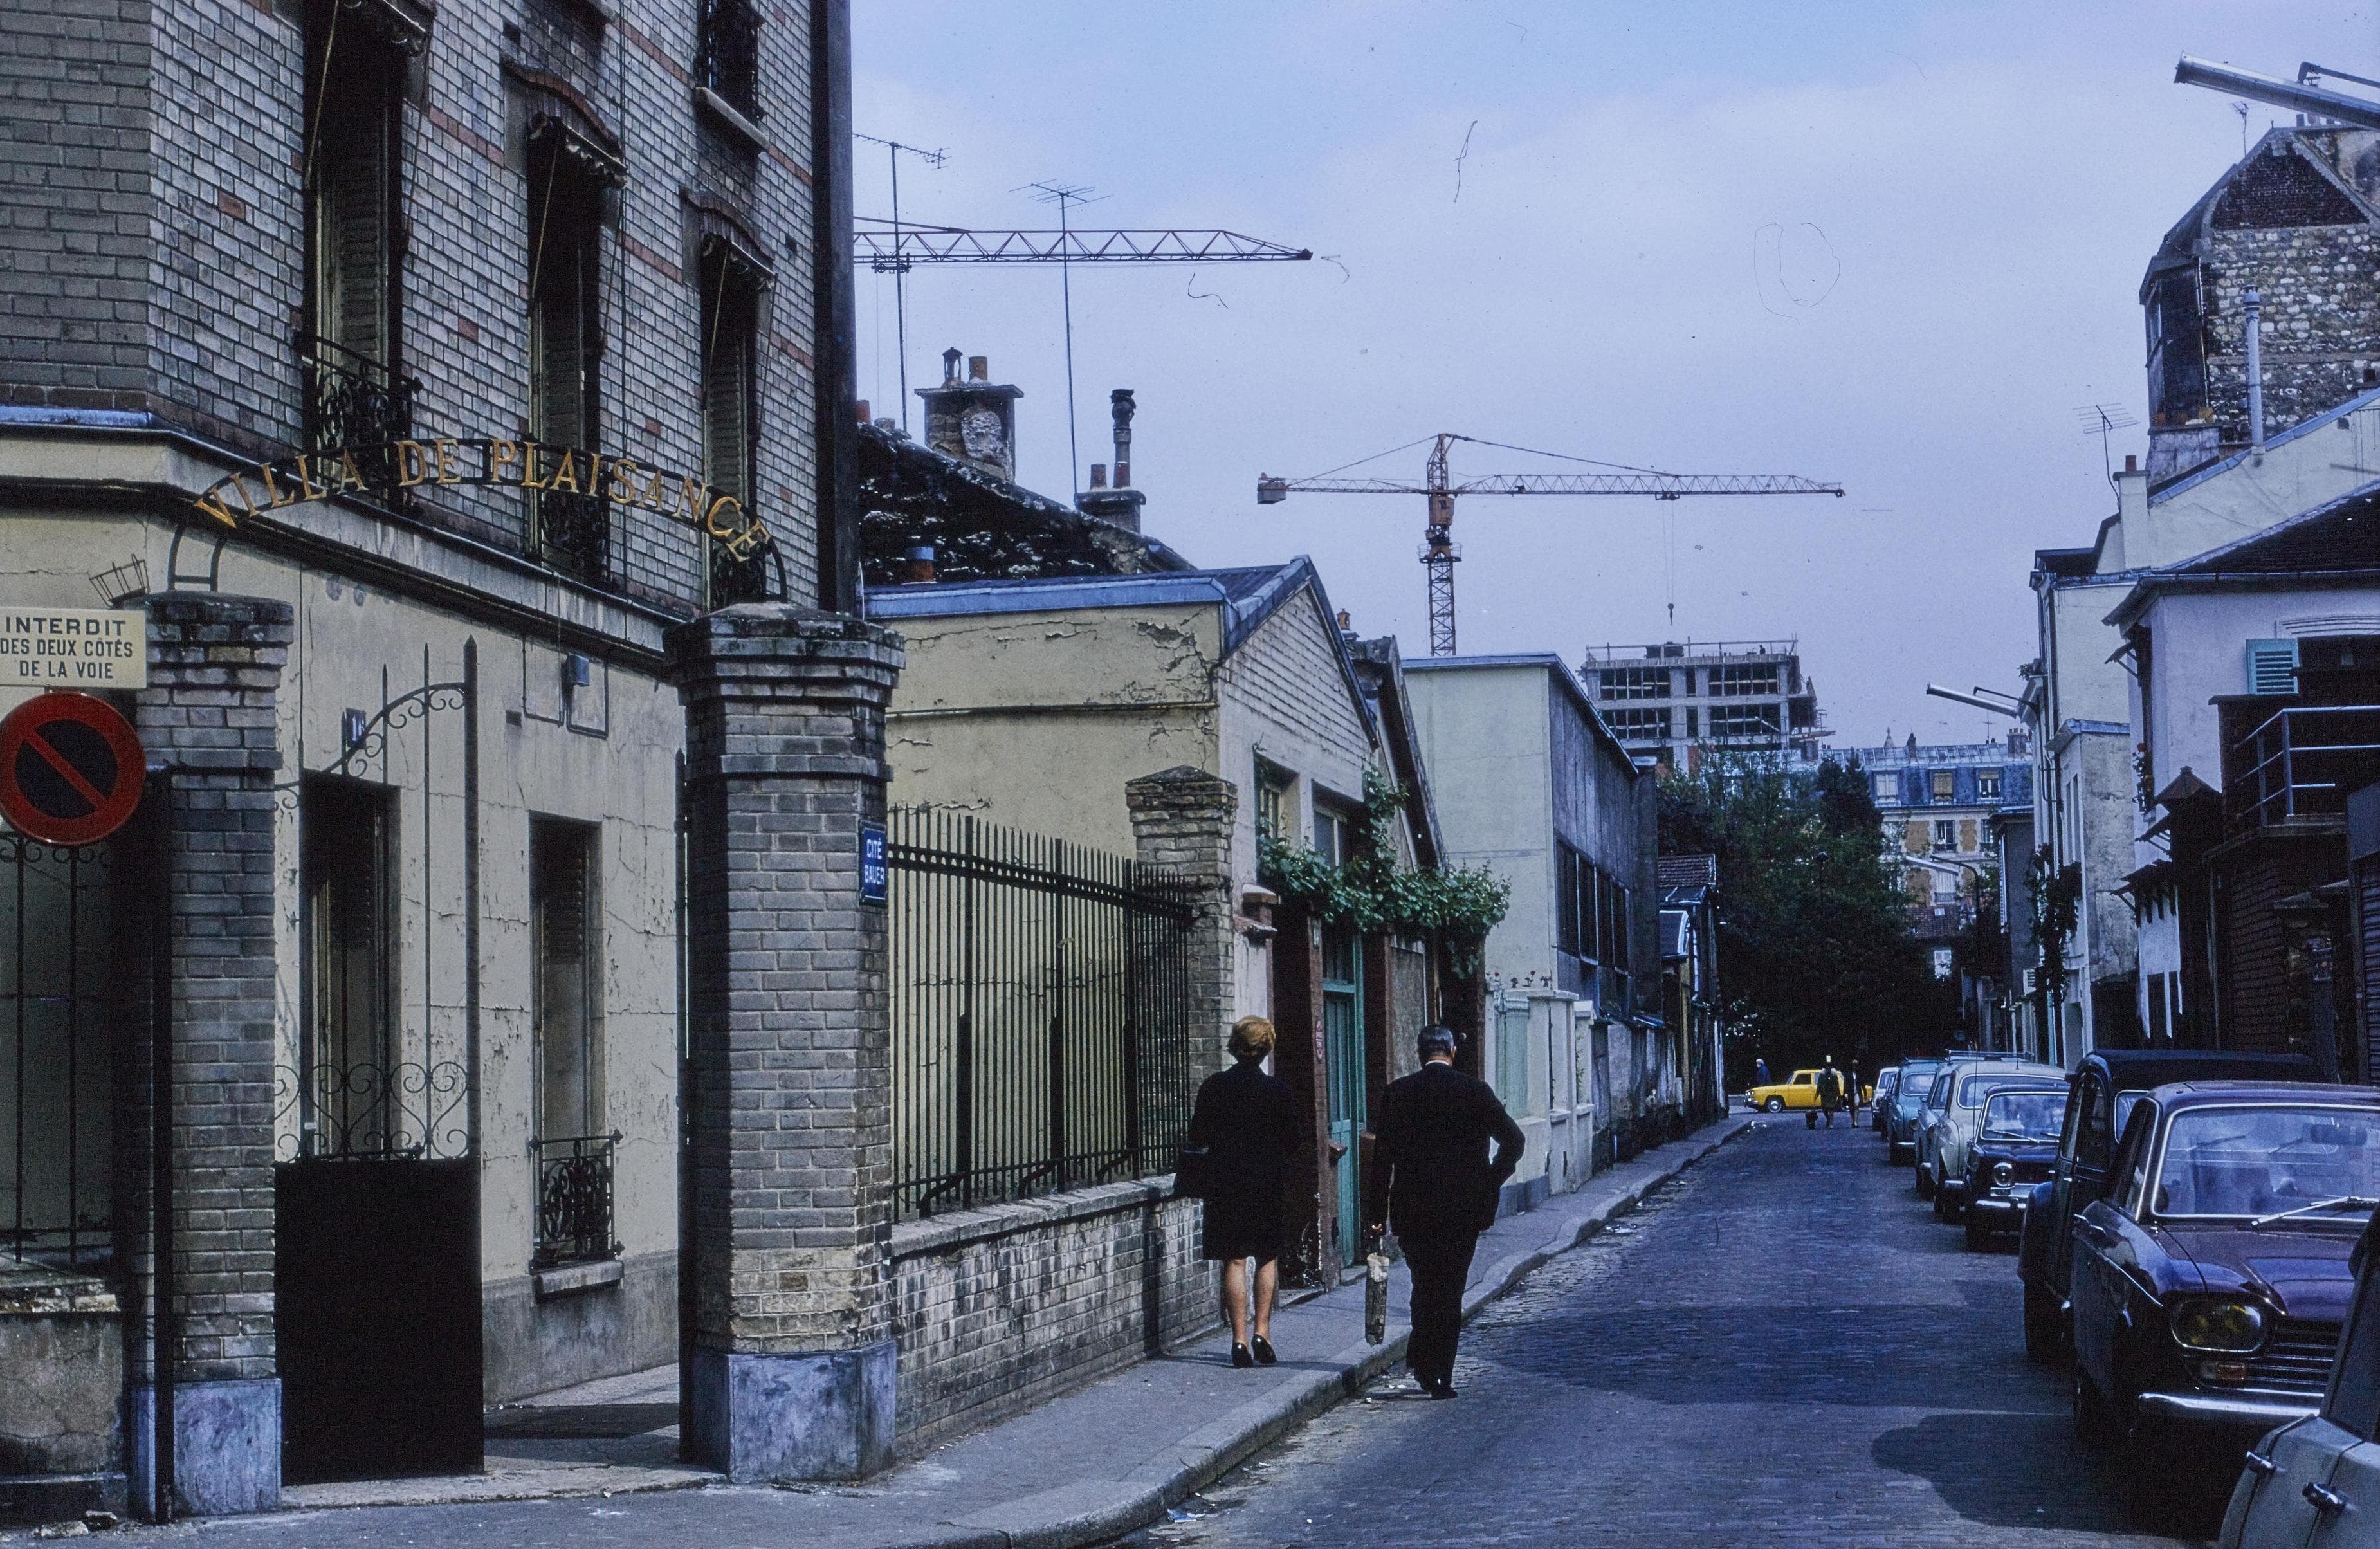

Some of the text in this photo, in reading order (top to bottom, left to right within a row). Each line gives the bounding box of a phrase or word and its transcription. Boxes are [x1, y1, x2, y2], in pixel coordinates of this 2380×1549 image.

[194, 438, 771, 562] VILLA DE PLAISANCE
[6, 616, 126, 636] INTERDIT
[0, 638, 133, 658] DES DEUX CÔTÉS
[20, 660, 113, 679] DE LA VOIE
[866, 838, 882, 859] CITÉ
[865, 865, 884, 885] BAUER
